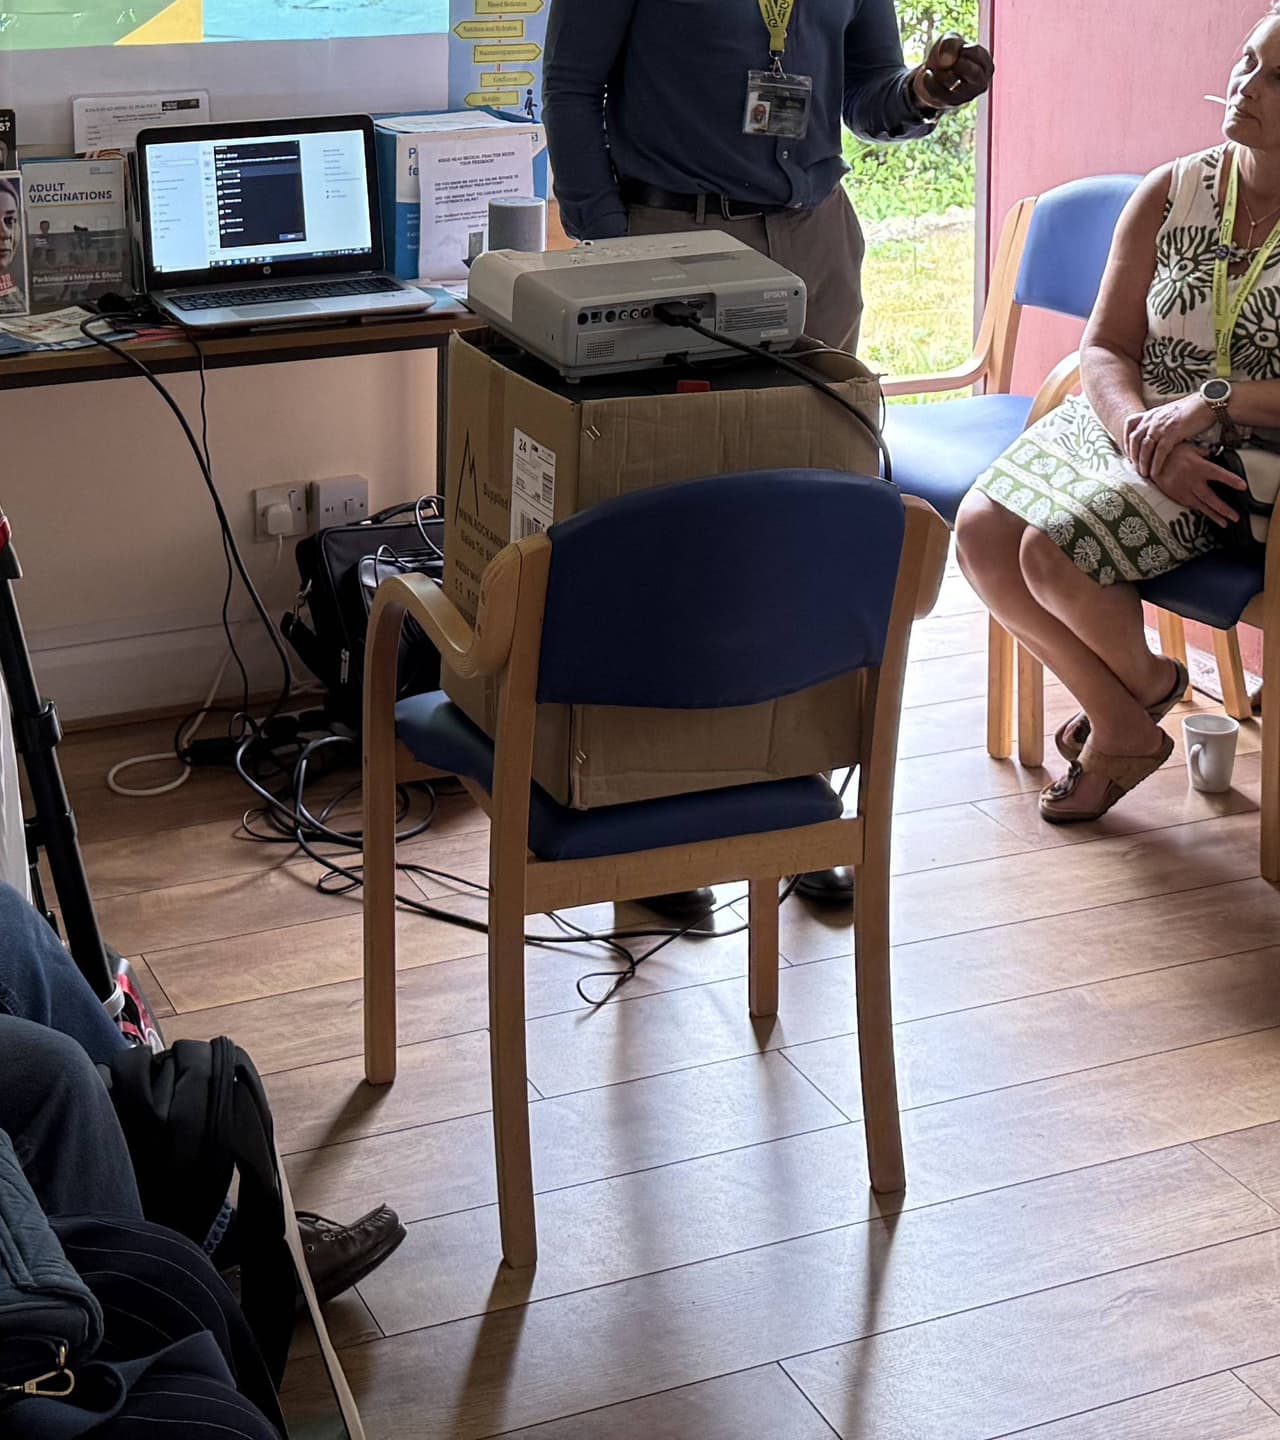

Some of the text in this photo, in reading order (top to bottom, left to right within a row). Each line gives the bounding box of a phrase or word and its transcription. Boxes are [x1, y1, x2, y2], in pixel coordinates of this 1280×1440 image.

[29, 182, 65, 193] ADULT
[29, 191, 113, 203] VACCINATIONS
[33, 274, 73, 282] Parkinson's
[519, 438, 527, 453] 24
